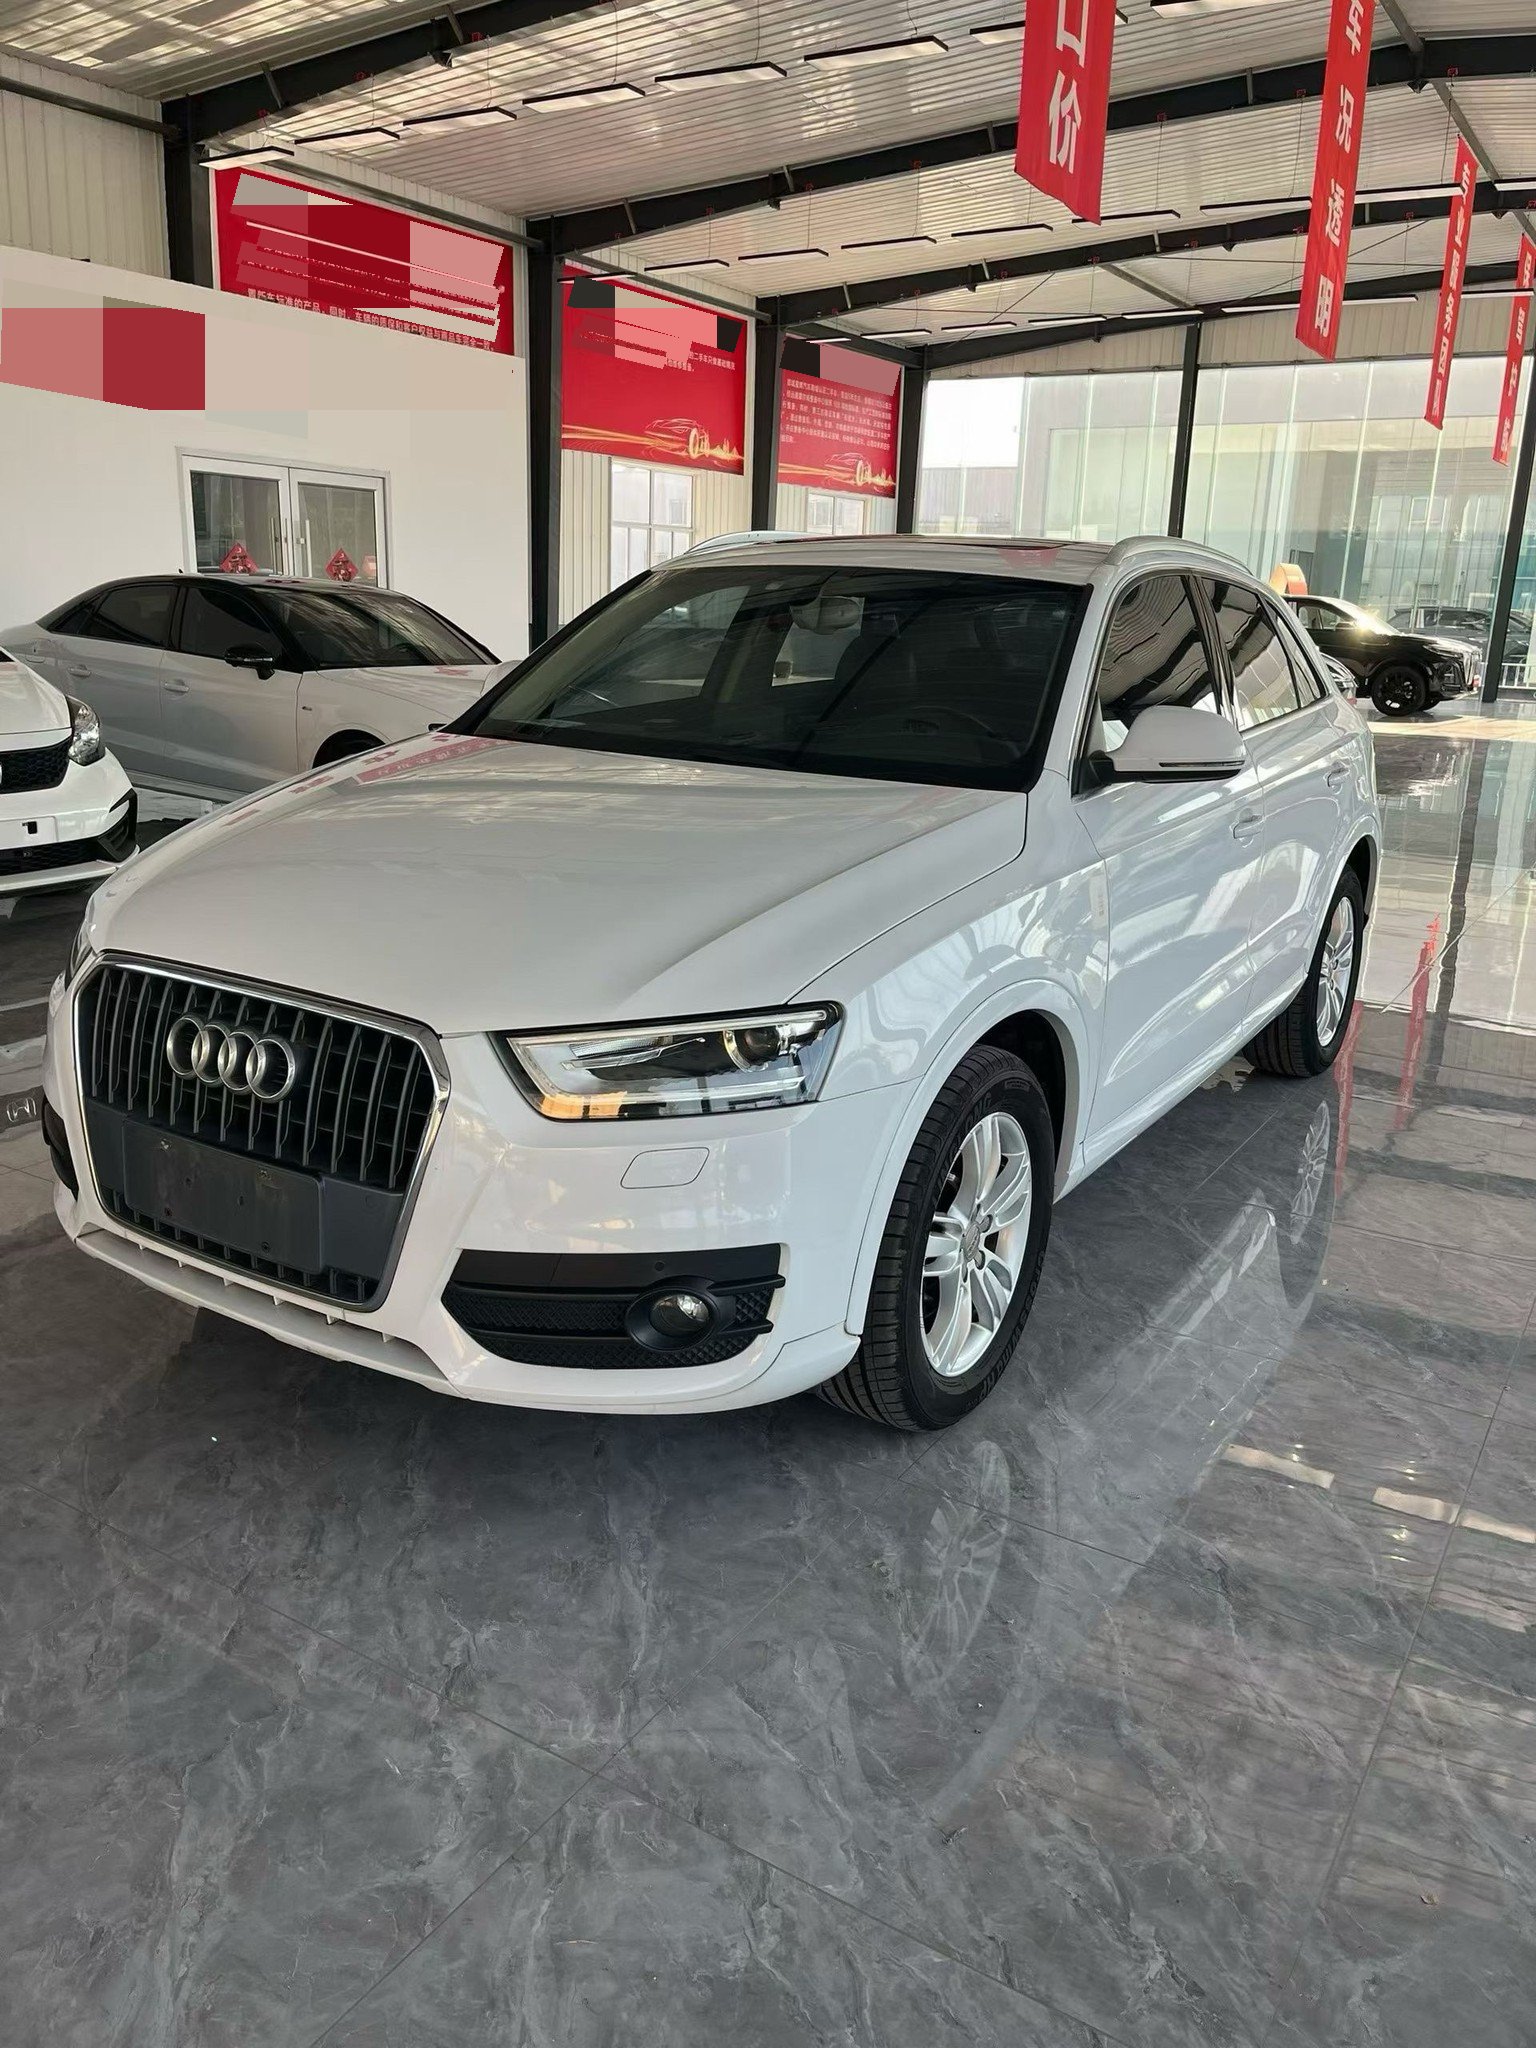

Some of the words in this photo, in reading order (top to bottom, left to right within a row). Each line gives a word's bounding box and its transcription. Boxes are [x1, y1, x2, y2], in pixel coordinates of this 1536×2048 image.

[1047, 0, 1089, 174] 口价
[1314, 0, 1365, 338] 车况透明
